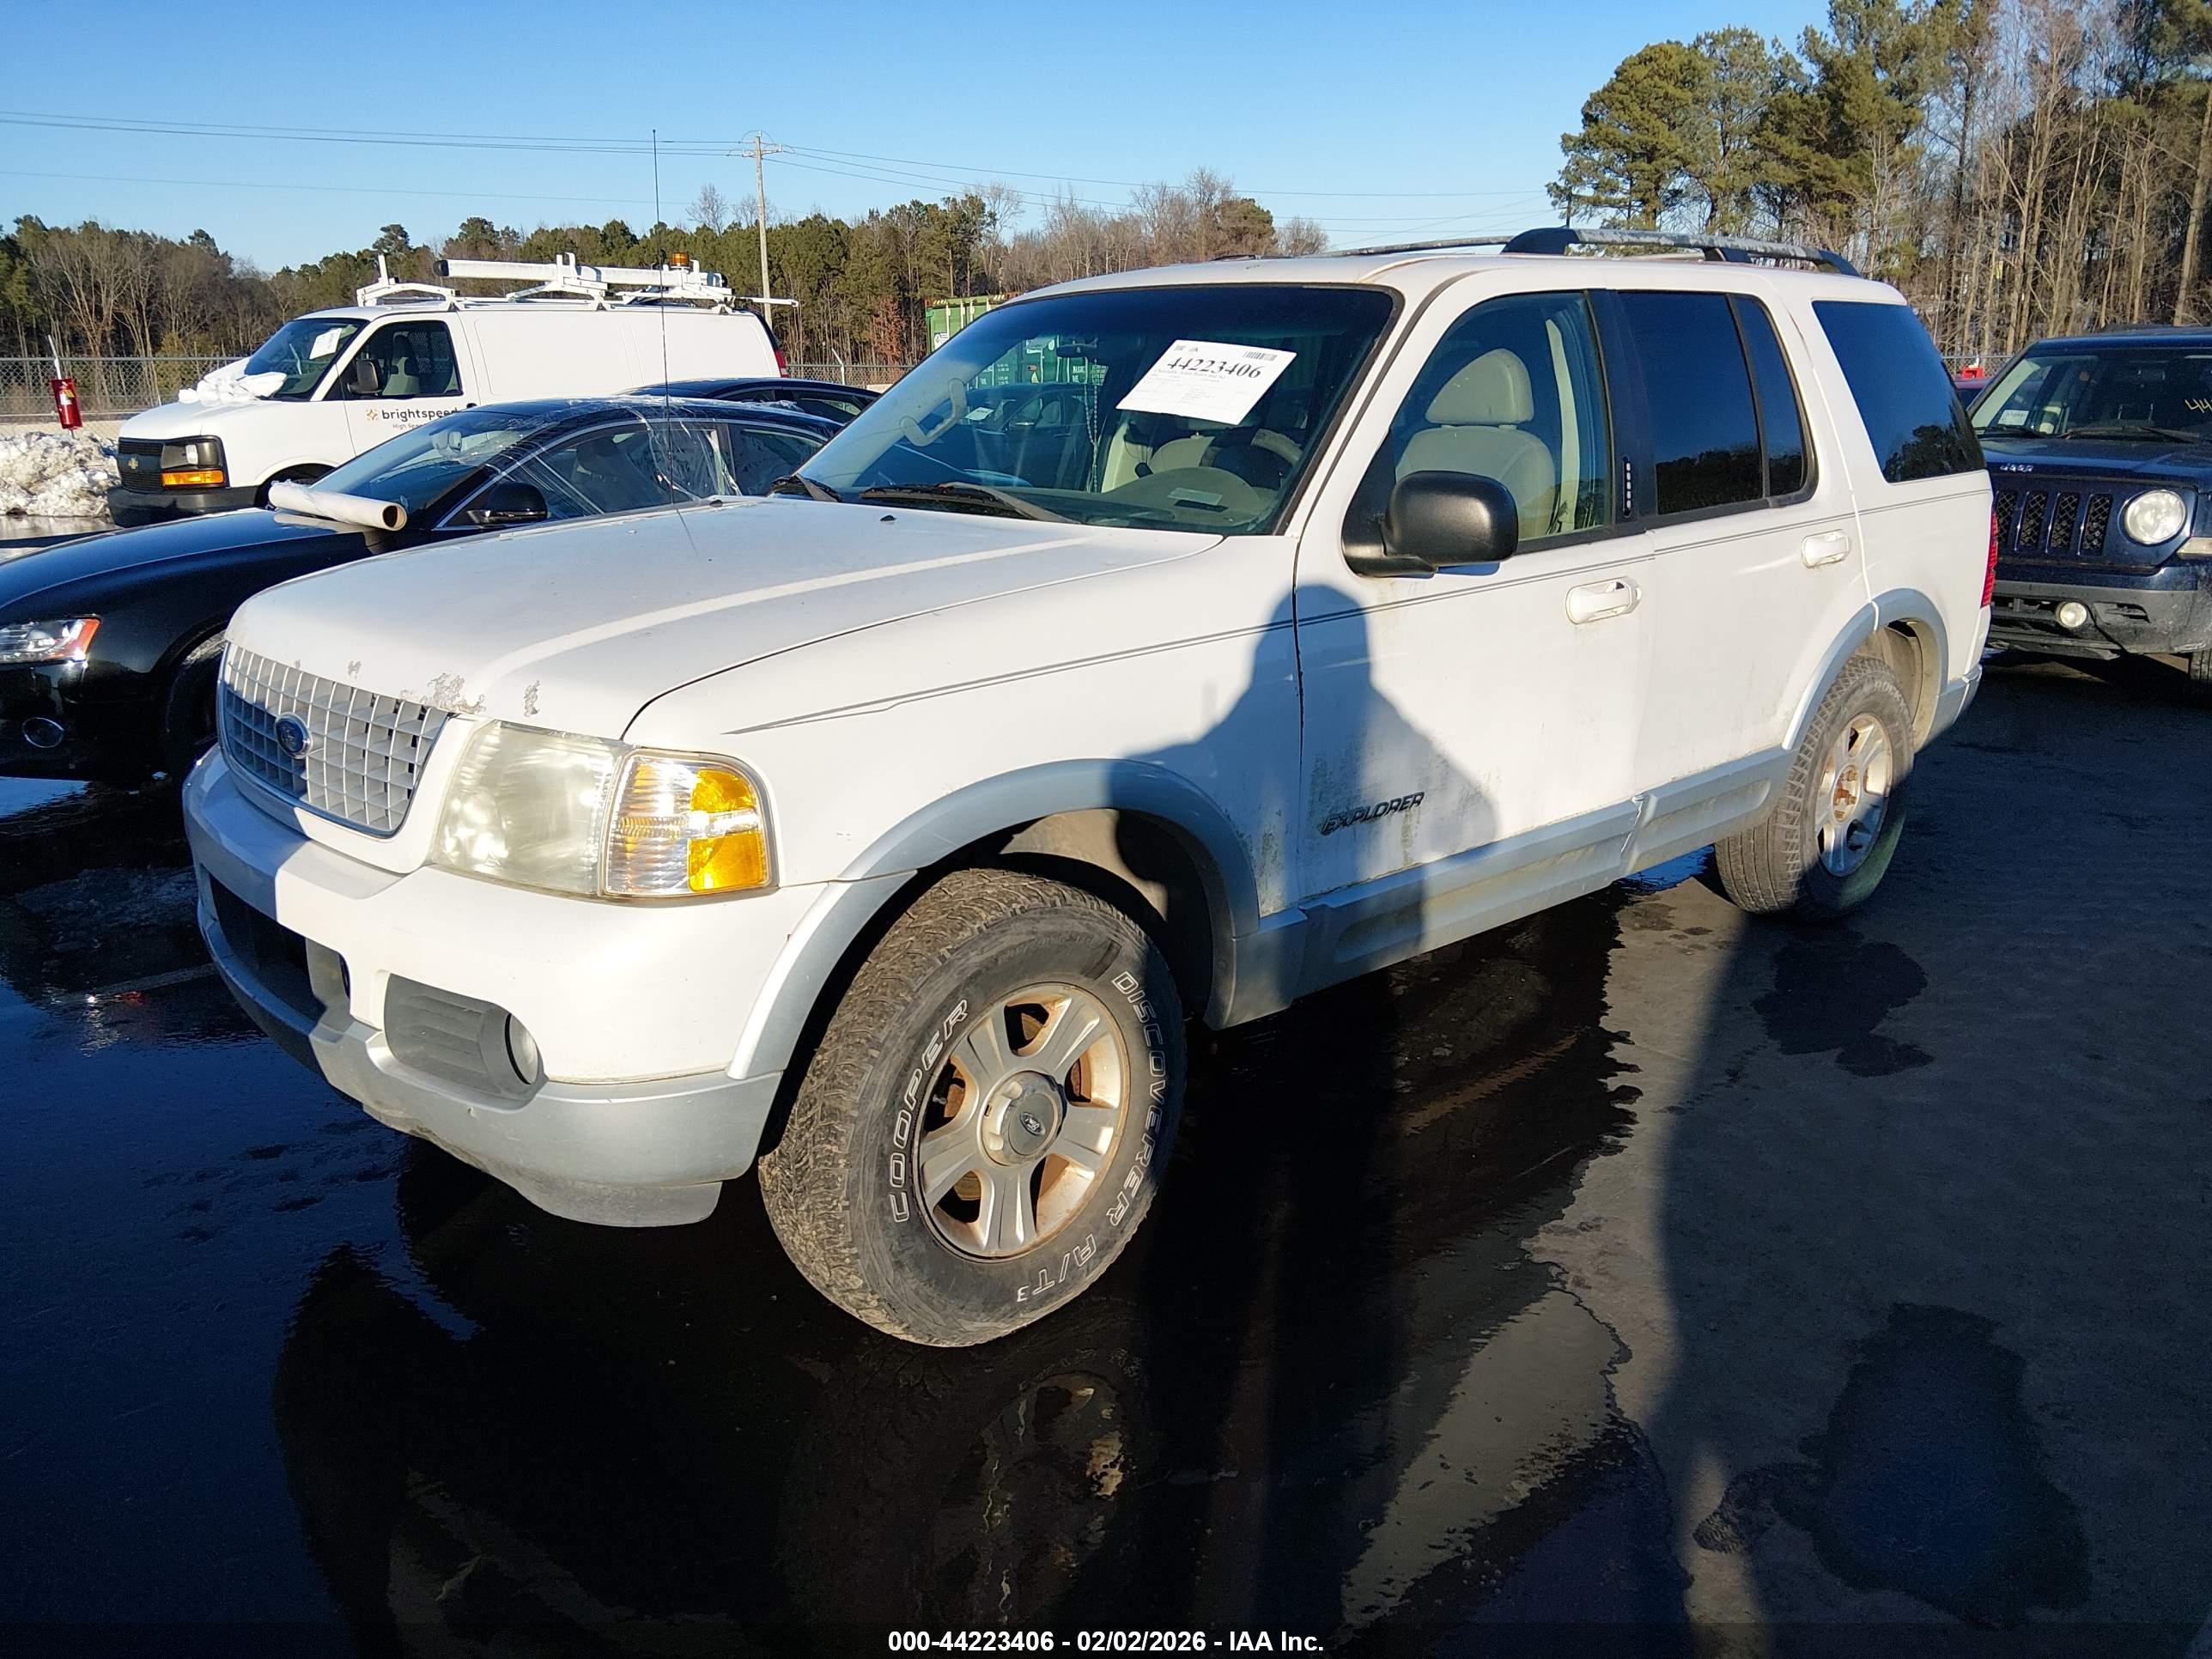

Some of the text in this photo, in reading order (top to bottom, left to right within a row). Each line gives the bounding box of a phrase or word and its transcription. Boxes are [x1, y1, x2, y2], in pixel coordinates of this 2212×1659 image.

[1167, 357, 1266, 378] 44223406
[2185, 398, 2212, 414] 44
[1320, 791, 1425, 836] EXPLORER
[889, 999, 969, 1224] COOPER
[1105, 970, 1166, 1227] DISCOVERER
